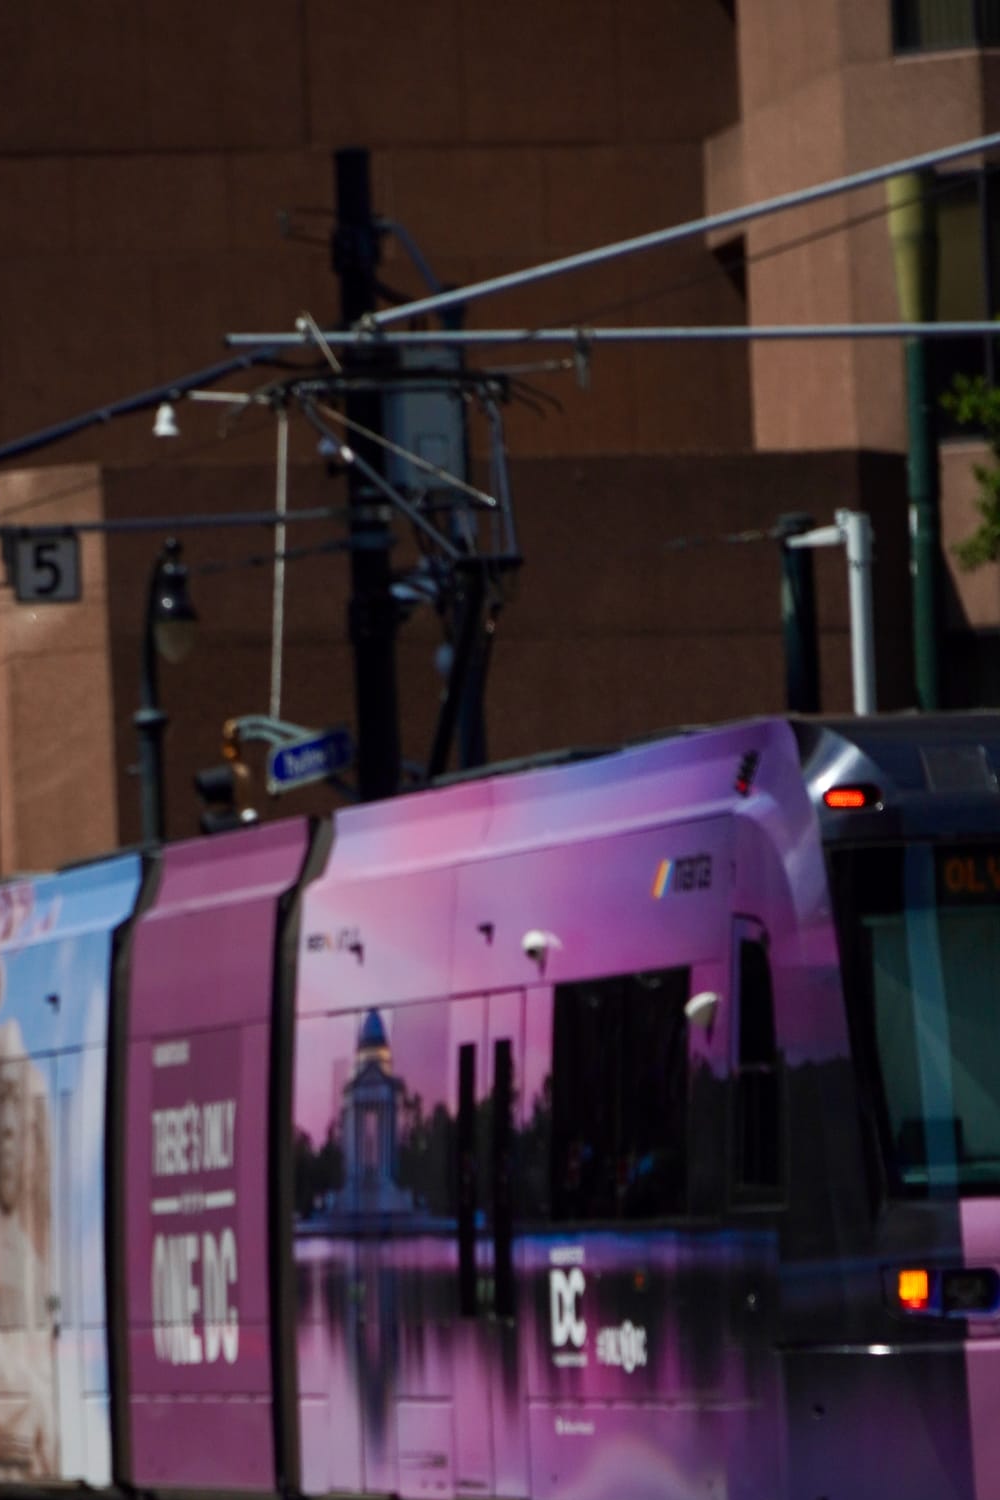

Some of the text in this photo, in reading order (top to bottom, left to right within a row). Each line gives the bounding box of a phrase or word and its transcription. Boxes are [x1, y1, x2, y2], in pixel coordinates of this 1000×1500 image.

[34, 543, 61, 596] 5
[203, 1227, 239, 1364] DC
[550, 1267, 587, 1347] DC
